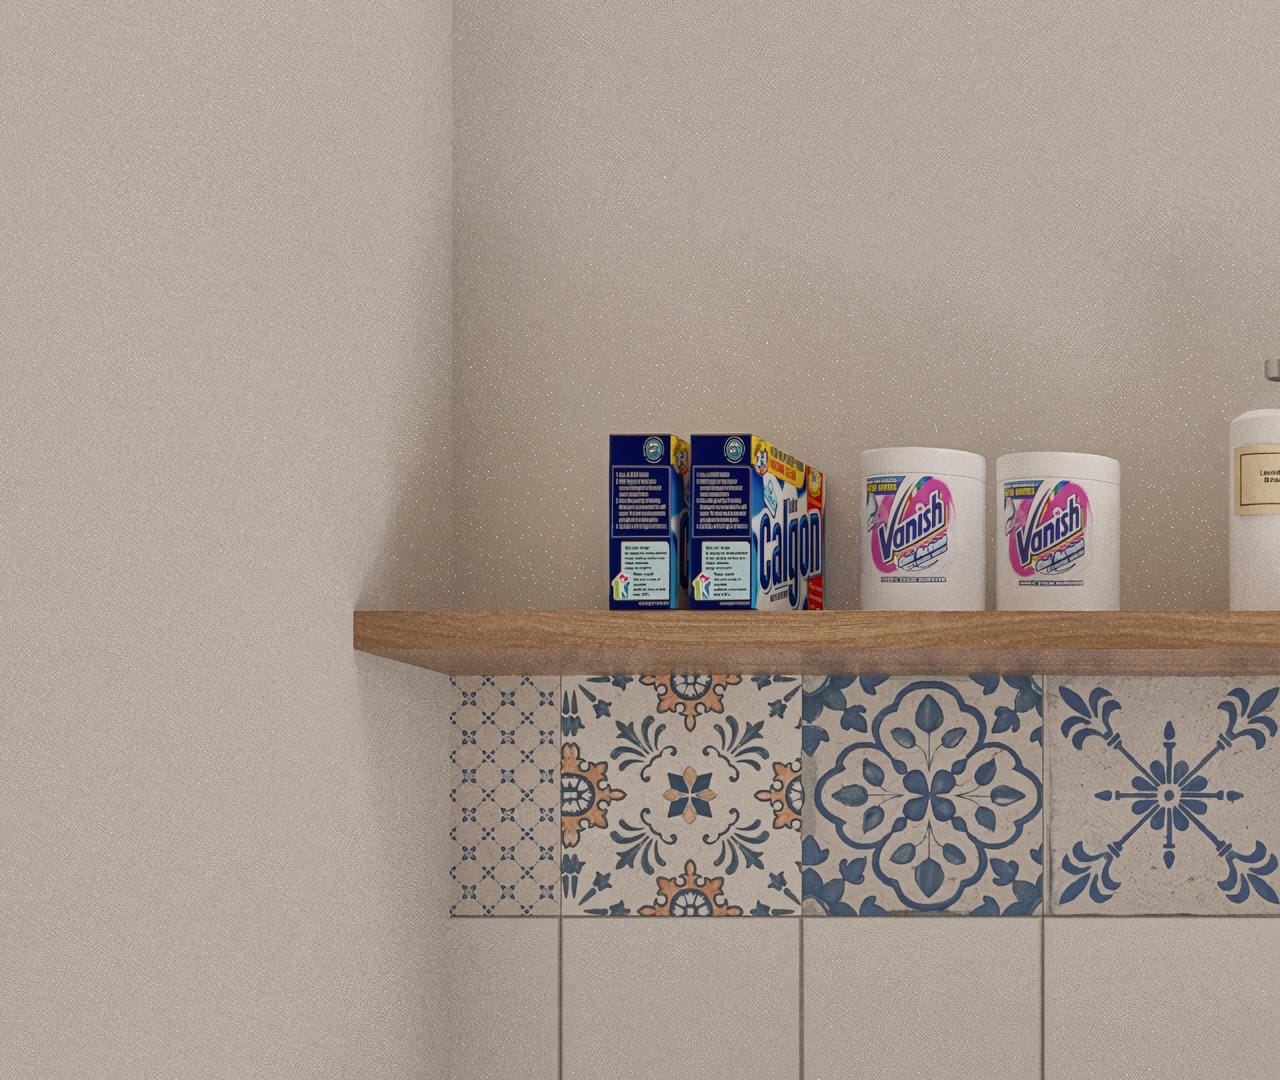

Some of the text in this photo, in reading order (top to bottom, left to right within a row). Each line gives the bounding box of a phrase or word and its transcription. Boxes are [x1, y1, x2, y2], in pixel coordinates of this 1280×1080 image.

[760, 499, 820, 608] Calgon
[879, 484, 944, 561] Vanish
[1016, 488, 1080, 565] Vanish
